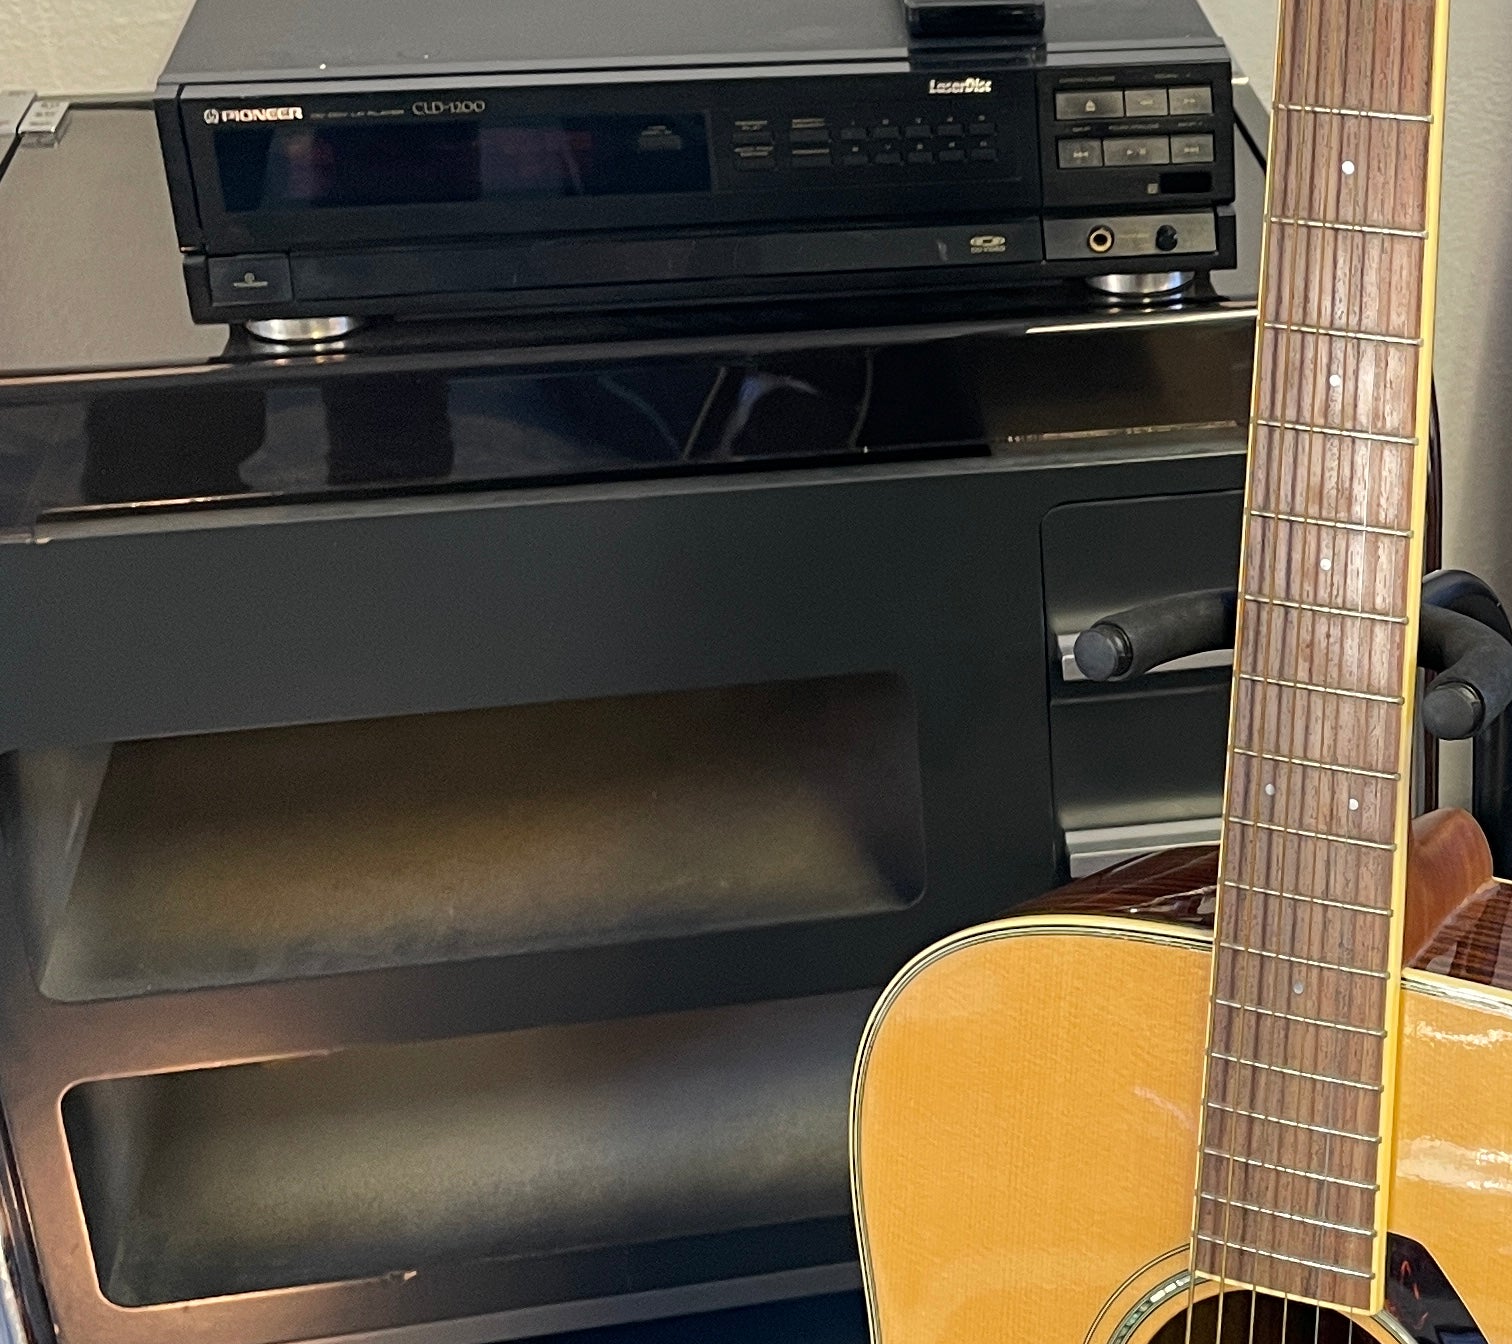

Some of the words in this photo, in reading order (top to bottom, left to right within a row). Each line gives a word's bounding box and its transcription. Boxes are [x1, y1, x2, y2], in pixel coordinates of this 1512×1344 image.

[929, 77, 992, 94] LaserDisc
[221, 106, 303, 122] PIONEER
[412, 100, 486, 115] CLD-1200
